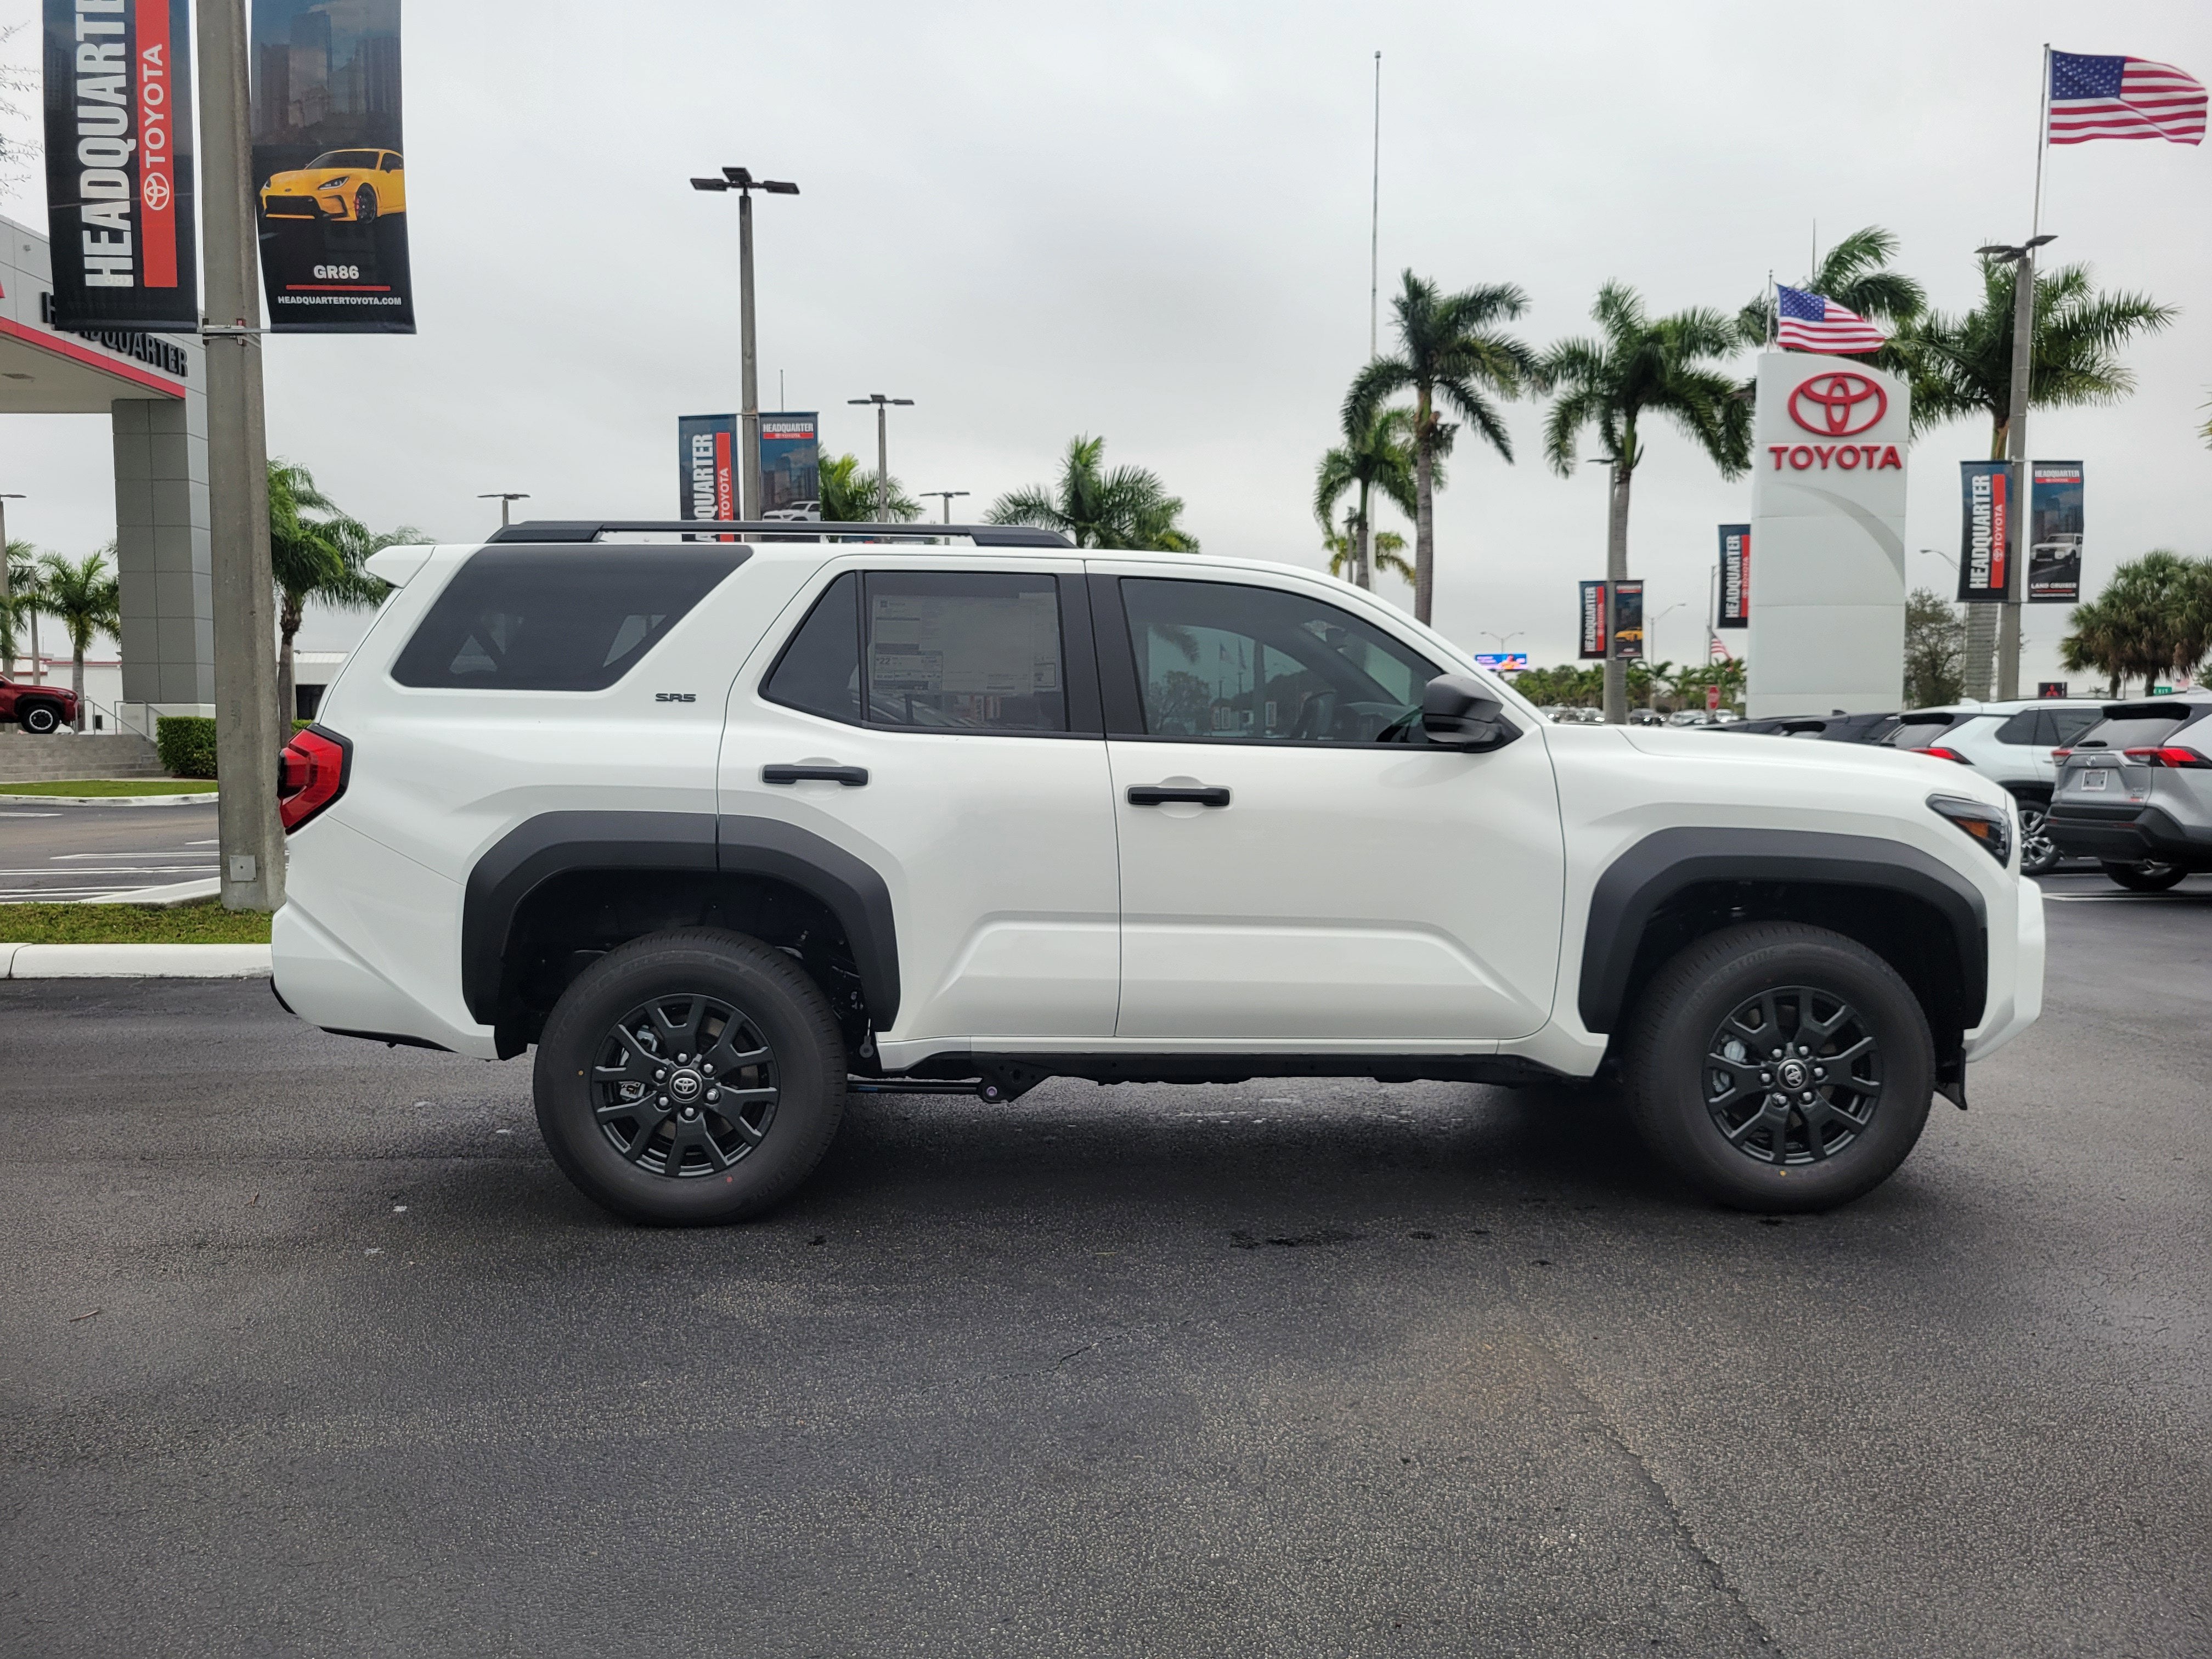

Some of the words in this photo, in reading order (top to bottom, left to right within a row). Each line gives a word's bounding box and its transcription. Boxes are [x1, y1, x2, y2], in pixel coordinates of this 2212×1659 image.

[142, 44, 166, 168] TOYOTA
[75, 0, 137, 286] HEADQUARTE
[313, 264, 360, 279] GR86
[278, 296, 402, 306] HEADQUARTERTOYOTA.COM
[762, 423, 814, 433] HEADQUARTER
[1768, 445, 1903, 470] TOYOTA
[720, 467, 731, 518] TOYOTA
[1969, 475, 1993, 589] HEADQUARTER
[1994, 503, 2004, 546] TOYOTA
[1725, 534, 1741, 618] HEADQUARTER
[655, 692, 696, 702] SR5
